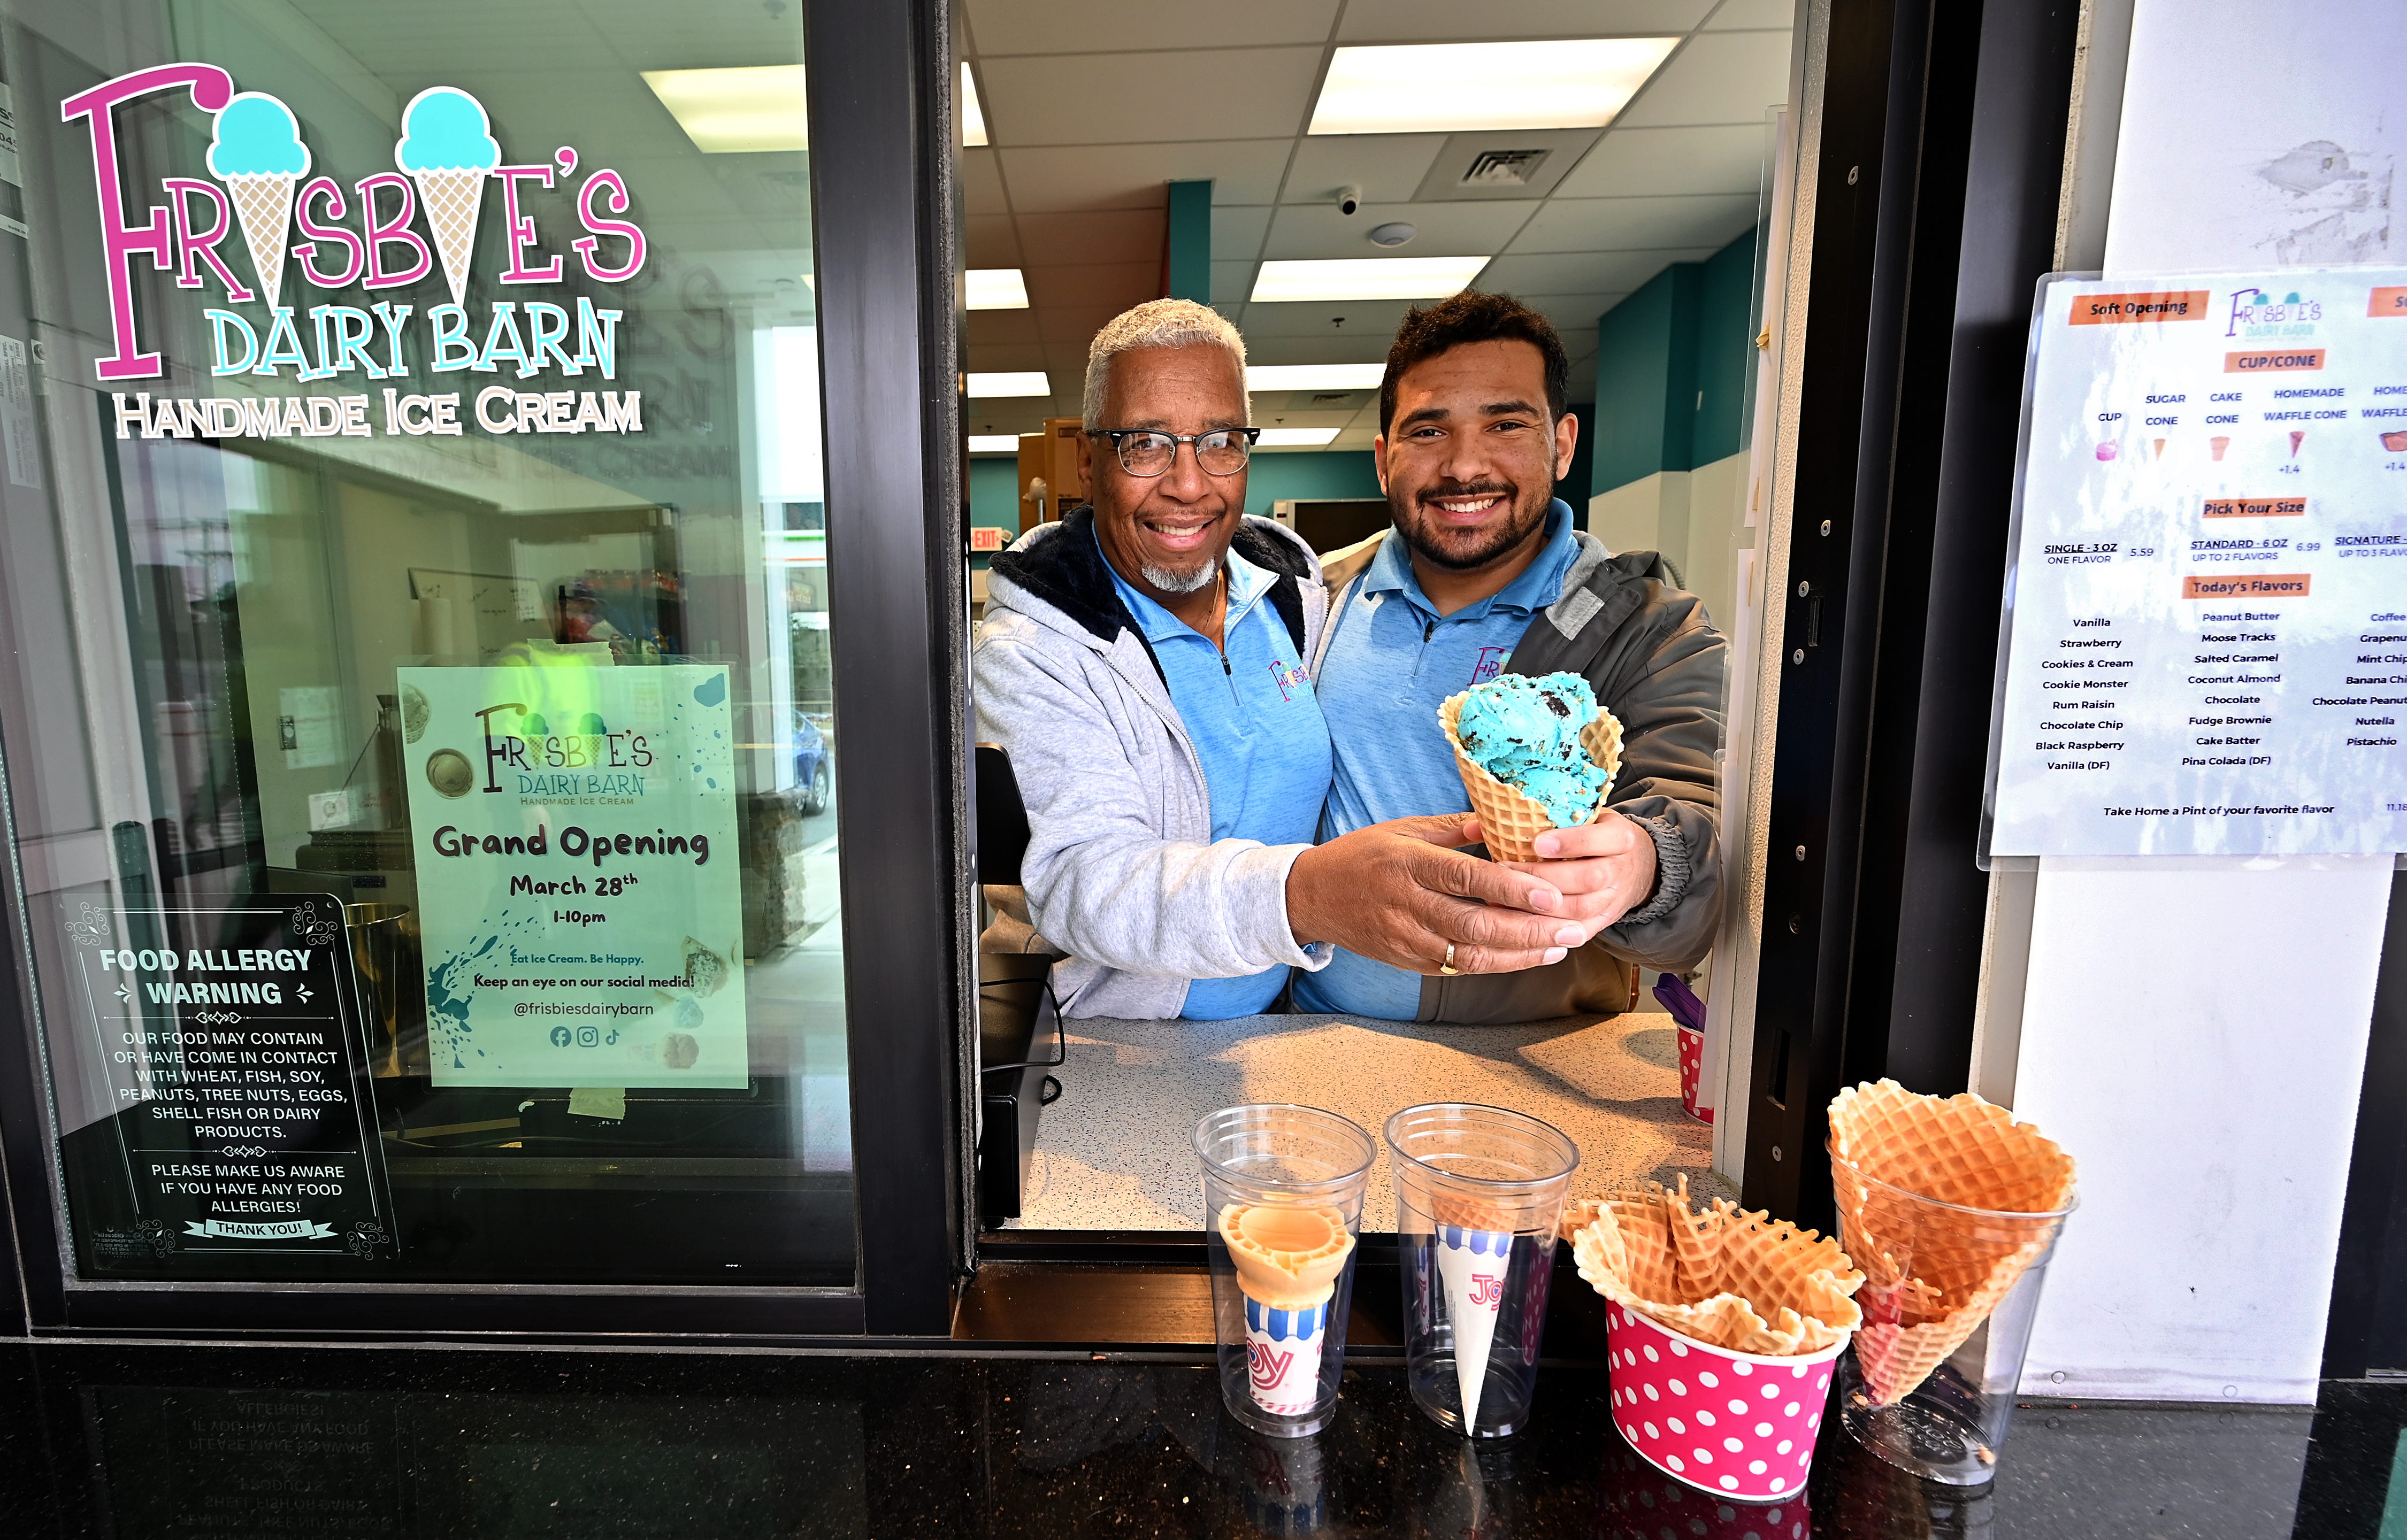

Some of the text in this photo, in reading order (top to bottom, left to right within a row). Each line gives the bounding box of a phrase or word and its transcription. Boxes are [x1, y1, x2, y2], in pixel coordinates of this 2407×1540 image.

[2090, 300, 2188, 317] Soft Opening
[205, 296, 623, 383] DAIRY BARN
[2239, 355, 2317, 368] CUP/CONE
[2210, 392, 2242, 402] CAKE
[2274, 388, 2345, 398] HOMEMADE
[2145, 394, 2186, 404] SUGAR
[112, 386, 642, 441] HANDMADE ICE CREAM
[2098, 413, 2122, 421] CUP
[2264, 410, 2347, 421] WAFFLE CONE
[2145, 417, 2179, 426] CONE
[2206, 414, 2239, 424] CONE
[2204, 501, 2304, 515] Pick Your Size
[975, 530, 996, 548] EXIT
[2191, 538, 2288, 549] STANDARD 6 OZ
[2335, 535, 2401, 545] SIGNATURE
[2044, 543, 2118, 553] SINGLE 3 OZ
[2296, 543, 2321, 551] 6.99
[2130, 548, 2153, 557] 5.59
[2193, 553, 2207, 562] UP
[2209, 553, 2222, 561] TO
[2233, 552, 2279, 561] FLAVORS
[2048, 555, 2111, 564] ONE FLAVOR
[2193, 580, 2303, 595] Today's Flavors
[2203, 613, 2280, 621] Peanut Butter
[2371, 613, 2406, 621] Coffee
[2073, 618, 2111, 627] Vanilla
[2202, 633, 2276, 642] Moose Tracks
[2059, 638, 2122, 649] Strawberry
[2194, 653, 2279, 663] Salted Caramel
[2357, 654, 2382, 663] Mint
[2042, 659, 2085, 669] Cookies
[2088, 660, 2095, 668] &
[2188, 674, 2281, 684] Coconut Almond
[2346, 676, 2387, 684] Banana
[2042, 680, 2129, 689] Cookie Monster
[2081, 699, 2115, 709] Raisin
[2205, 695, 2260, 704] Chocolate
[2312, 697, 2367, 706] Chocolate
[2040, 720, 2124, 730] Chocolate Chip
[2189, 715, 2272, 727] Fudge Brownie
[2356, 717, 2395, 726] Nutella
[2036, 741, 2125, 751] Black Raspberry
[2196, 737, 2260, 745] Cake Batter
[2347, 737, 2397, 746] Pistachio
[2047, 761, 2110, 771] Vanilla (DF)
[2182, 756, 2271, 766] Pina Colada (DF)
[518, 774, 645, 796] DAIRY BARN
[520, 797, 576, 805] HANDMADE
[599, 797, 634, 805] CREAM
[2103, 805, 2335, 817] Take Home Pint of your favorite flavor
[433, 824, 709, 866] Grand Opening
[510, 873, 639, 897] March 28th
[554, 910, 606, 928] 1-10pm
[100, 949, 311, 972] FOOD ALLERGY
[511, 954, 645, 967] Eat Ice Cream. Be Happy.
[474, 973, 694, 990] Keep an eye on our social media!
[145, 983, 282, 1004] WARNING
[514, 1002, 654, 1018] @frisbiesdairybarn
[123, 1032, 324, 1045] OUR FOOD MAY CONTAIN
[114, 1051, 338, 1064] OR HAVE COME IN CONTACT
[135, 1069, 325, 1084] WITH WHEAT, FISH, SOY,
[120, 1088, 348, 1103] PEANUTS, TREE NUTS, EGGS,
[152, 1107, 321, 1120] SHELL FISH OR DAIRY
[195, 1125, 287, 1138] PRODUCTS.
[151, 1165, 345, 1178] PLEASE MAKE US AWARE
[160, 1182, 342, 1196] IF YOU HAVE ANY FOOD
[211, 1200, 301, 1213] ALLERGIES!
[216, 1222, 303, 1235] THANK YOU!
